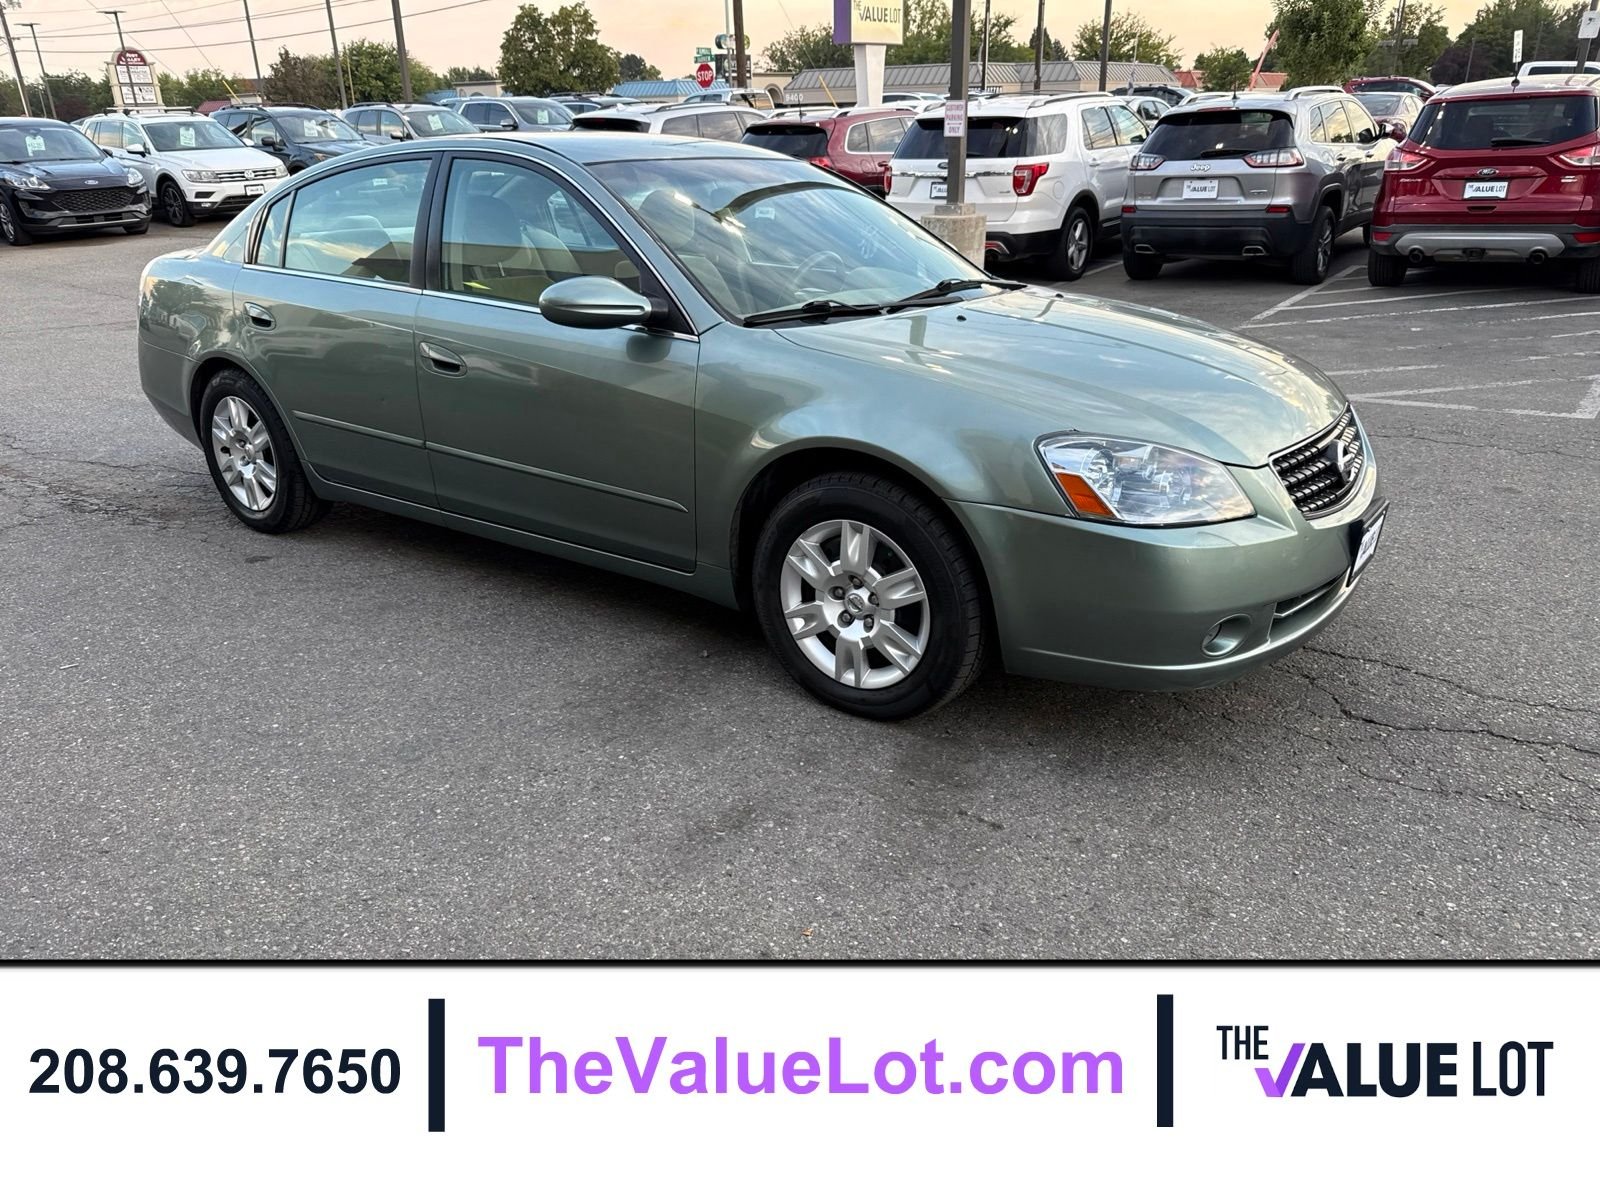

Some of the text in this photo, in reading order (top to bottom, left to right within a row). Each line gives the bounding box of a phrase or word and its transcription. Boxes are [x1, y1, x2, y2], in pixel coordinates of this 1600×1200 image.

[859, 5, 888, 23] VALUE
[889, 7, 901, 23] LOT
[697, 71, 713, 81] STOP
[1190, 164, 1211, 172] Jeep
